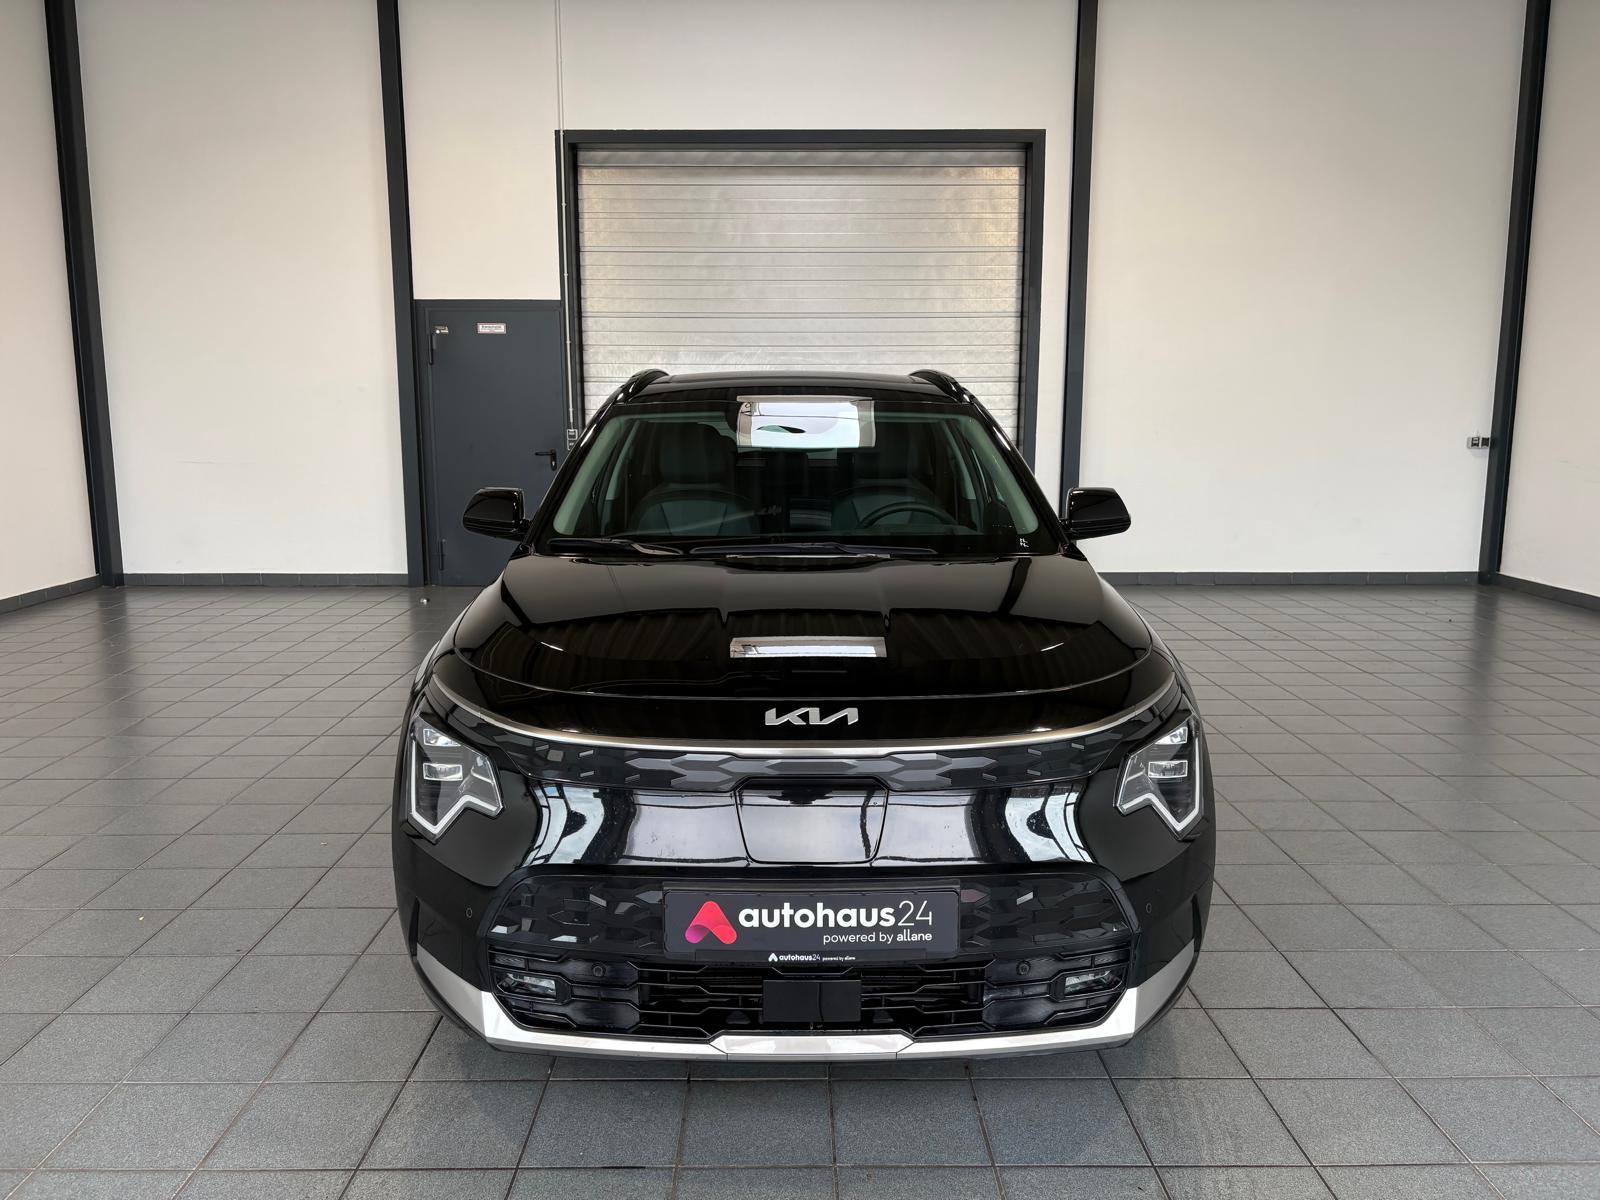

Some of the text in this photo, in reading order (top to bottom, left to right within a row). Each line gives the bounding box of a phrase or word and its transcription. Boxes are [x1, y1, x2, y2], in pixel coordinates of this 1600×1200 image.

[765, 707, 859, 725] KIA
[738, 900, 933, 928] autohaus24
[823, 929, 932, 945] powered by allane
[779, 953, 820, 961] autohaus24
